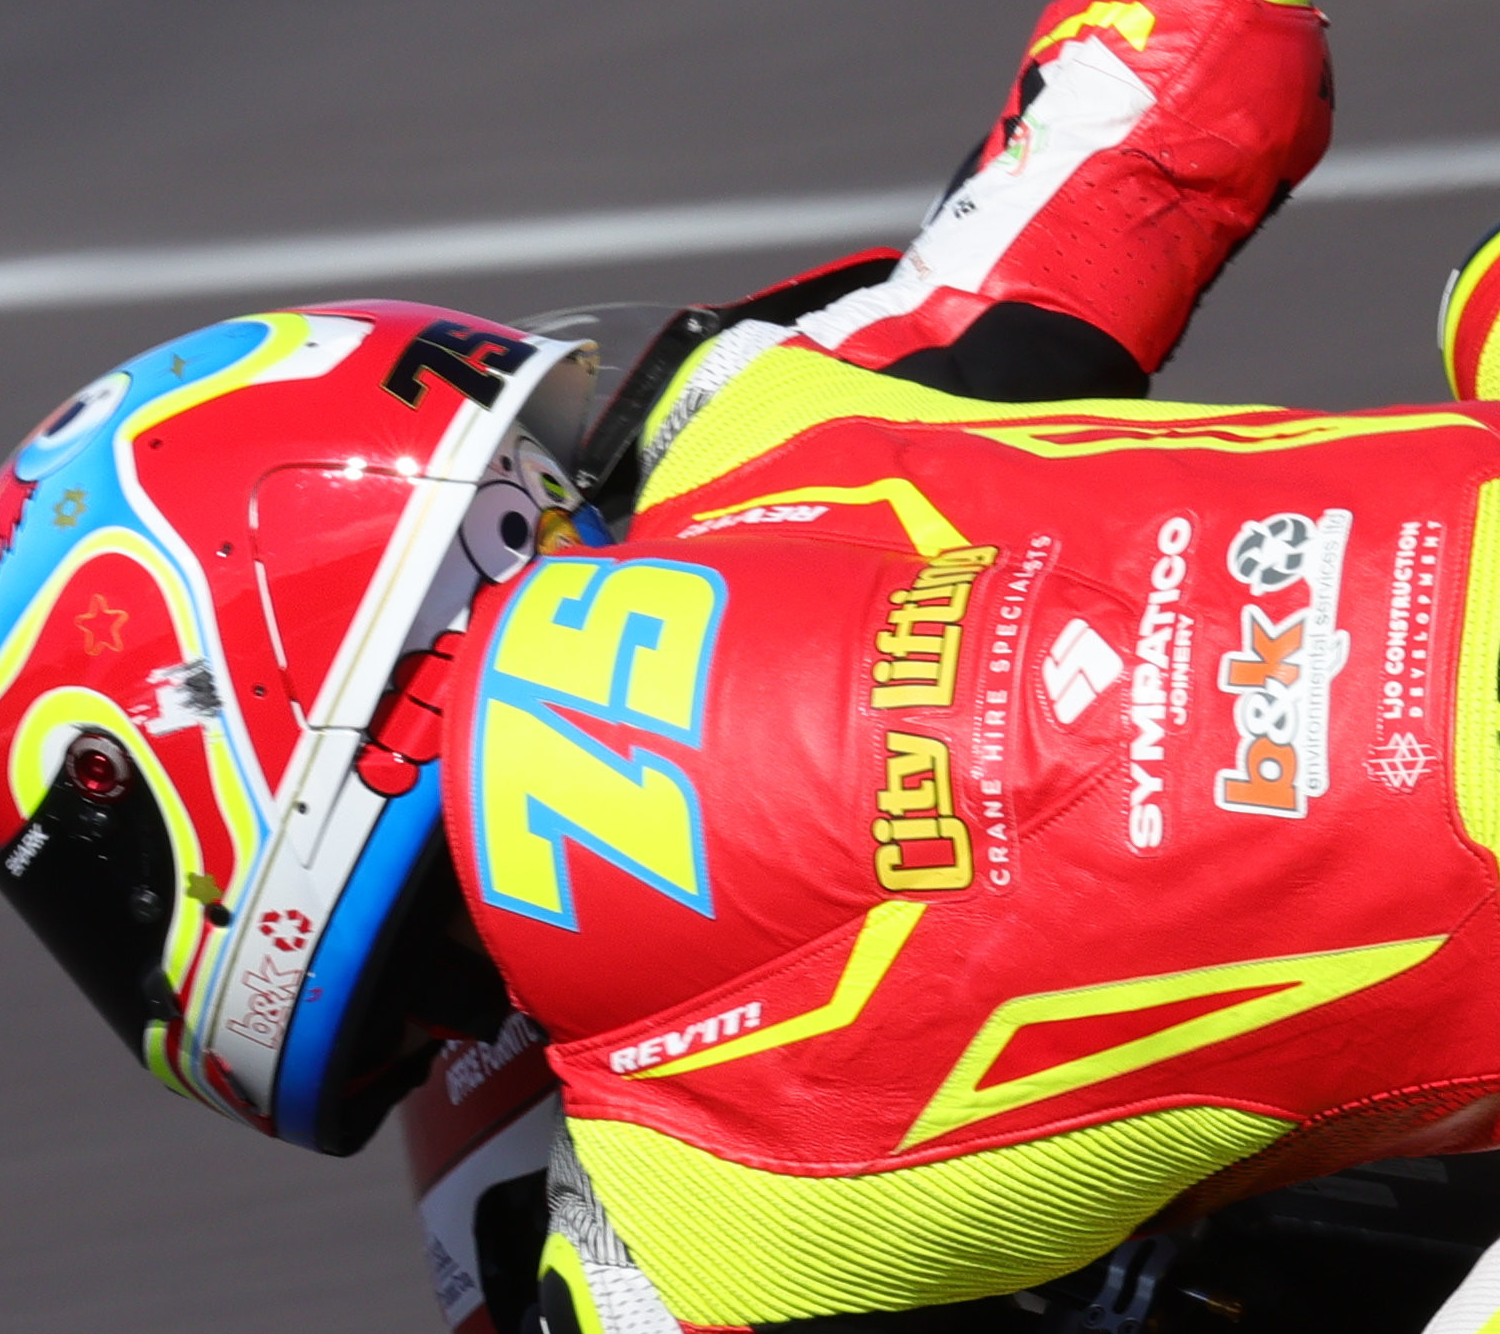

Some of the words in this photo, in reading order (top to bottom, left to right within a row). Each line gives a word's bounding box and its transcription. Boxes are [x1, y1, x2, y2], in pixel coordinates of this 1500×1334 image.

[383, 317, 539, 410] 75
[1172, 614, 1195, 726] JOINERY
[1301, 633, 1329, 790] environmental
[1315, 540, 1338, 625] services
[1385, 521, 1420, 675] CONSTRUCTION
[1410, 520, 1441, 717] DEVELOPMENT
[477, 555, 730, 933] 75
[984, 689, 1008, 760] HIRE
[1129, 516, 1192, 849] SYMPATICO
[1216, 607, 1305, 816] b&k
[1382, 680, 1404, 719] LJO
[4, 822, 49, 878] SHARK
[874, 731, 974, 892] City
[981, 778, 1011, 886] CRANE
